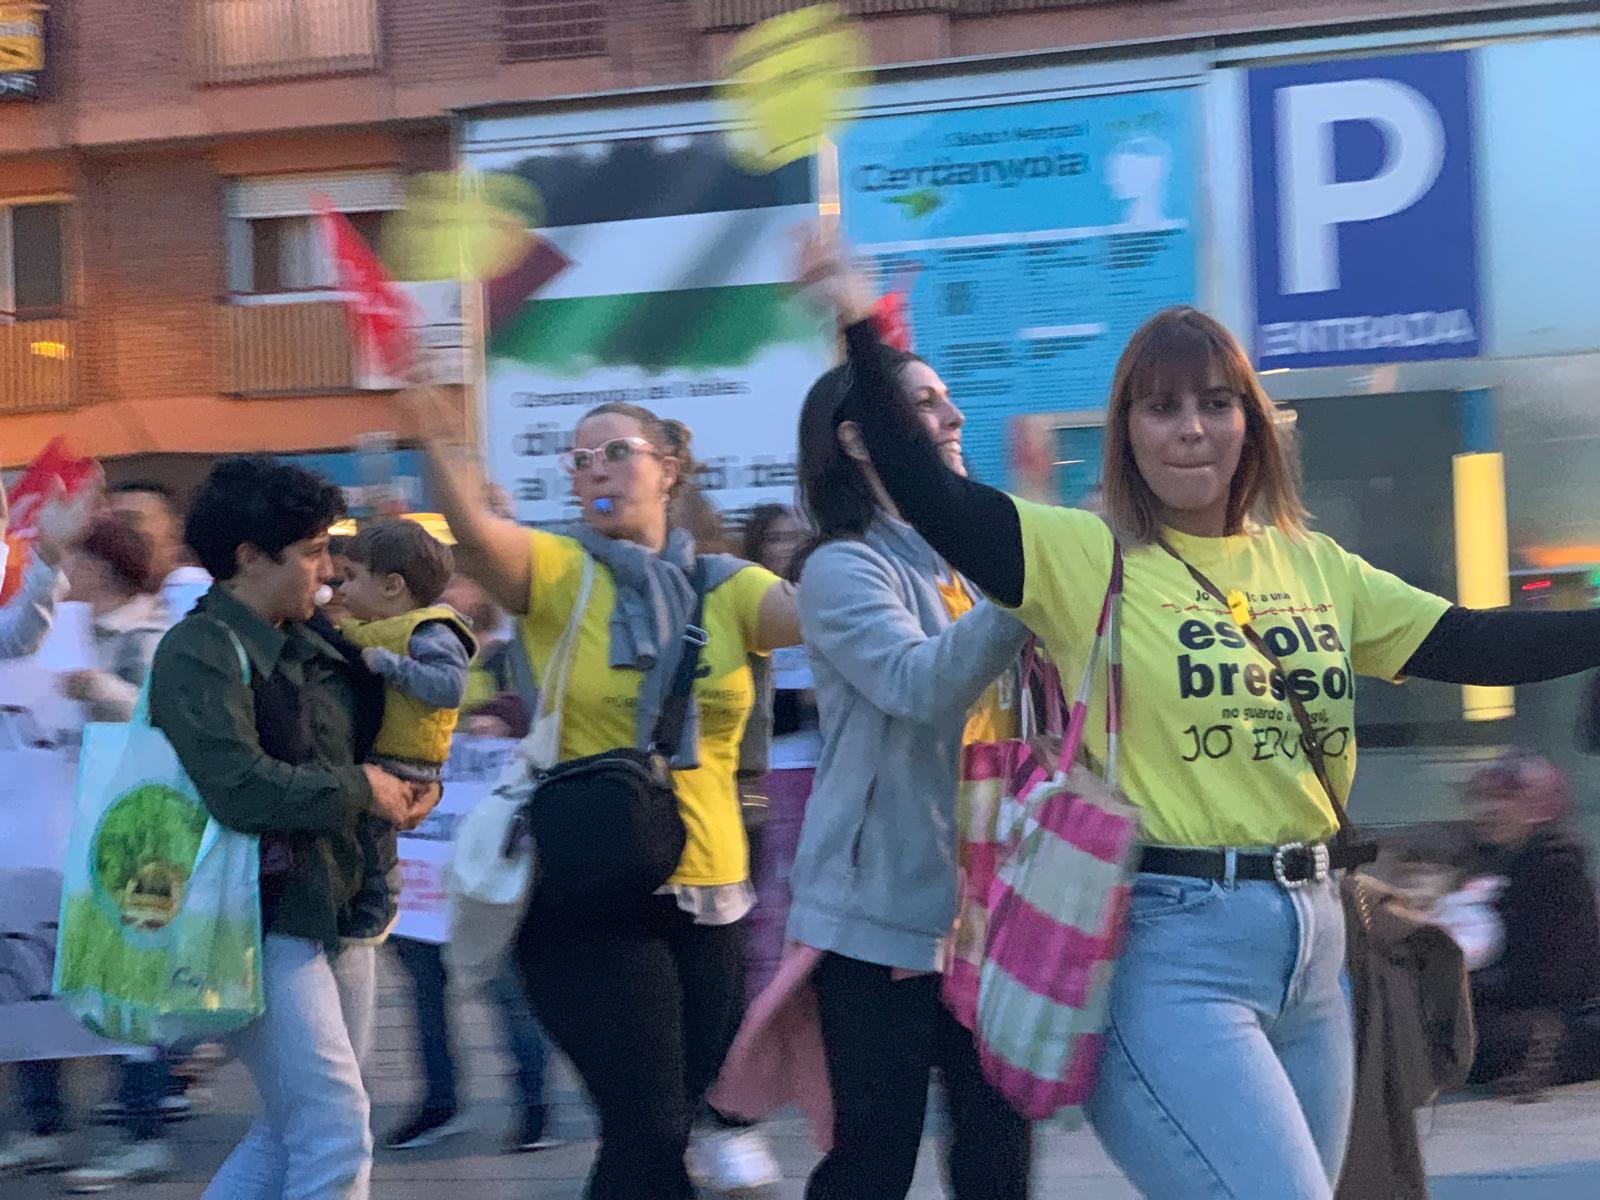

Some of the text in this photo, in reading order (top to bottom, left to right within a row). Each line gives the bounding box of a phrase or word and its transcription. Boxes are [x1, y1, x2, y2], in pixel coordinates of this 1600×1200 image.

[1274, 78, 1446, 295] P
[1261, 309, 1478, 356] ENTRADA
[1178, 616, 1346, 657] esola
[1222, 708, 1239, 719] no
[1243, 706, 1284, 722] guardo
[1182, 725, 1232, 762] JO
